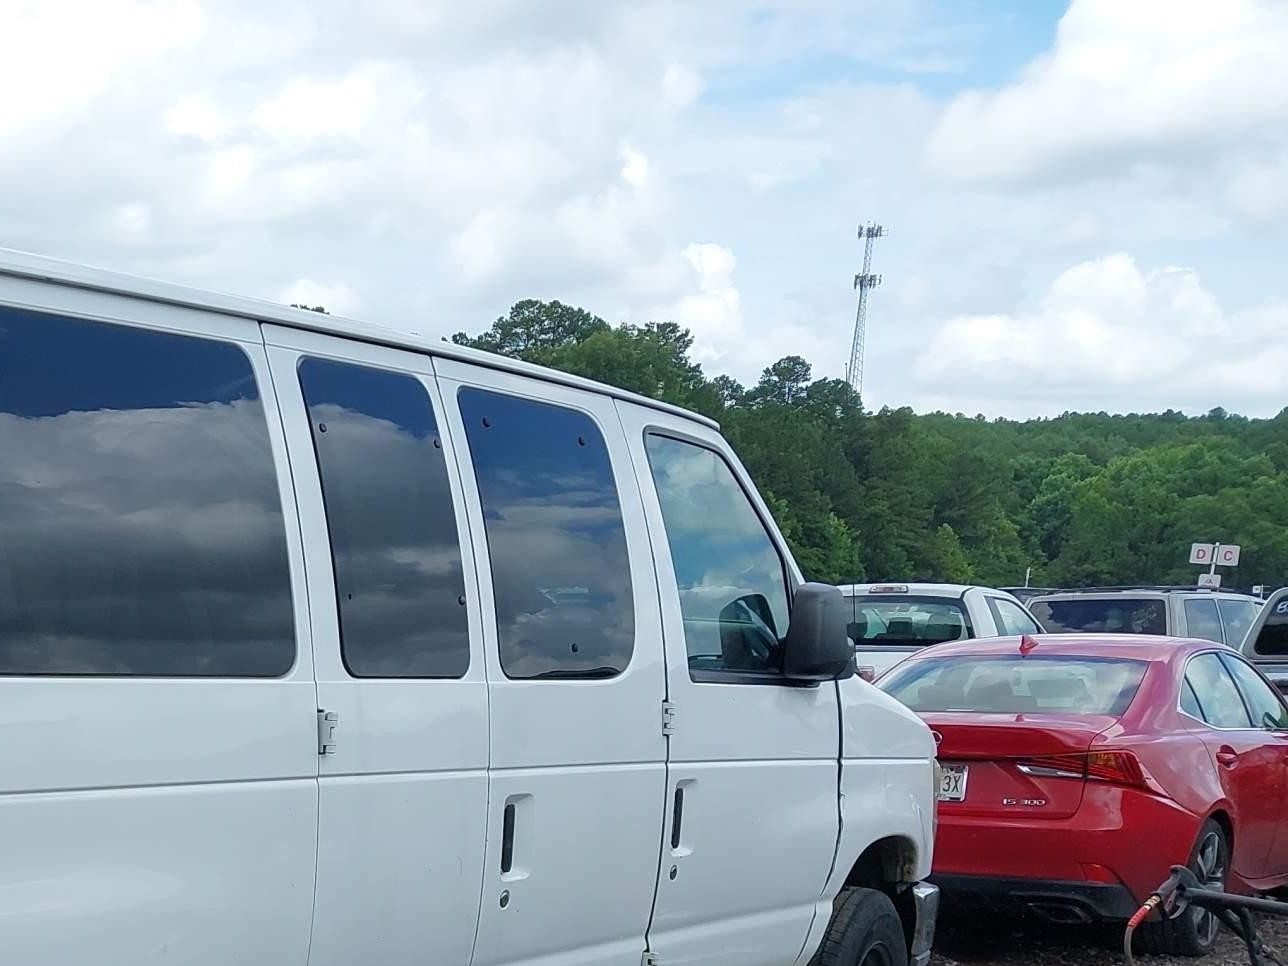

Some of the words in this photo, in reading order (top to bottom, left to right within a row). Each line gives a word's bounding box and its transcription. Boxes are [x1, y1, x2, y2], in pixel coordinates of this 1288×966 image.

[1196, 548, 1207, 560] D
[1223, 550, 1234, 562] C
[1277, 601, 1288, 614] 8
[1003, 798, 1017, 806] IS
